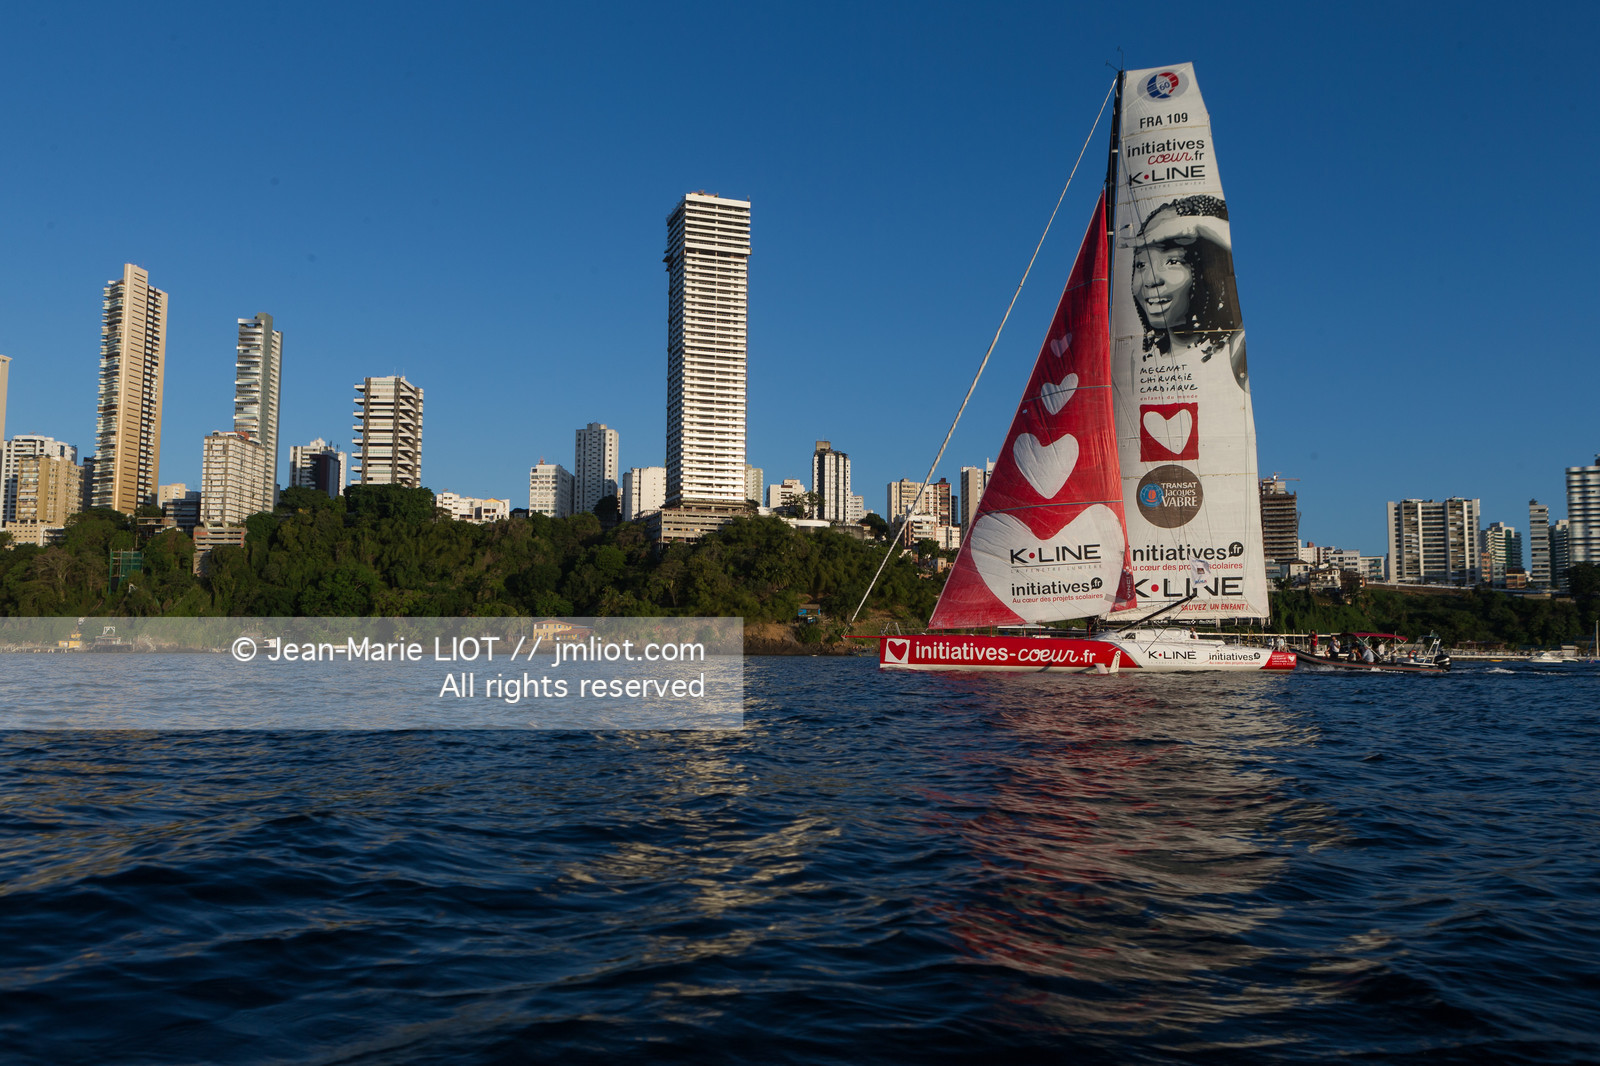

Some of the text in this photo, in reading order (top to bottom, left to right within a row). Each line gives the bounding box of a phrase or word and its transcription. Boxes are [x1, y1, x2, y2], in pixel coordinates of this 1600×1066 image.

[1140, 112, 1188, 129] FRA 109
[1127, 138, 1205, 158] initiatives
[1164, 489, 1196, 498] Jacques
[1161, 495, 1198, 507] VABRE
[1162, 563, 1177, 571] des
[1011, 581, 1090, 596] initiatives
[1053, 594, 1074, 602] projets
[1209, 653, 1254, 661] initiatives
